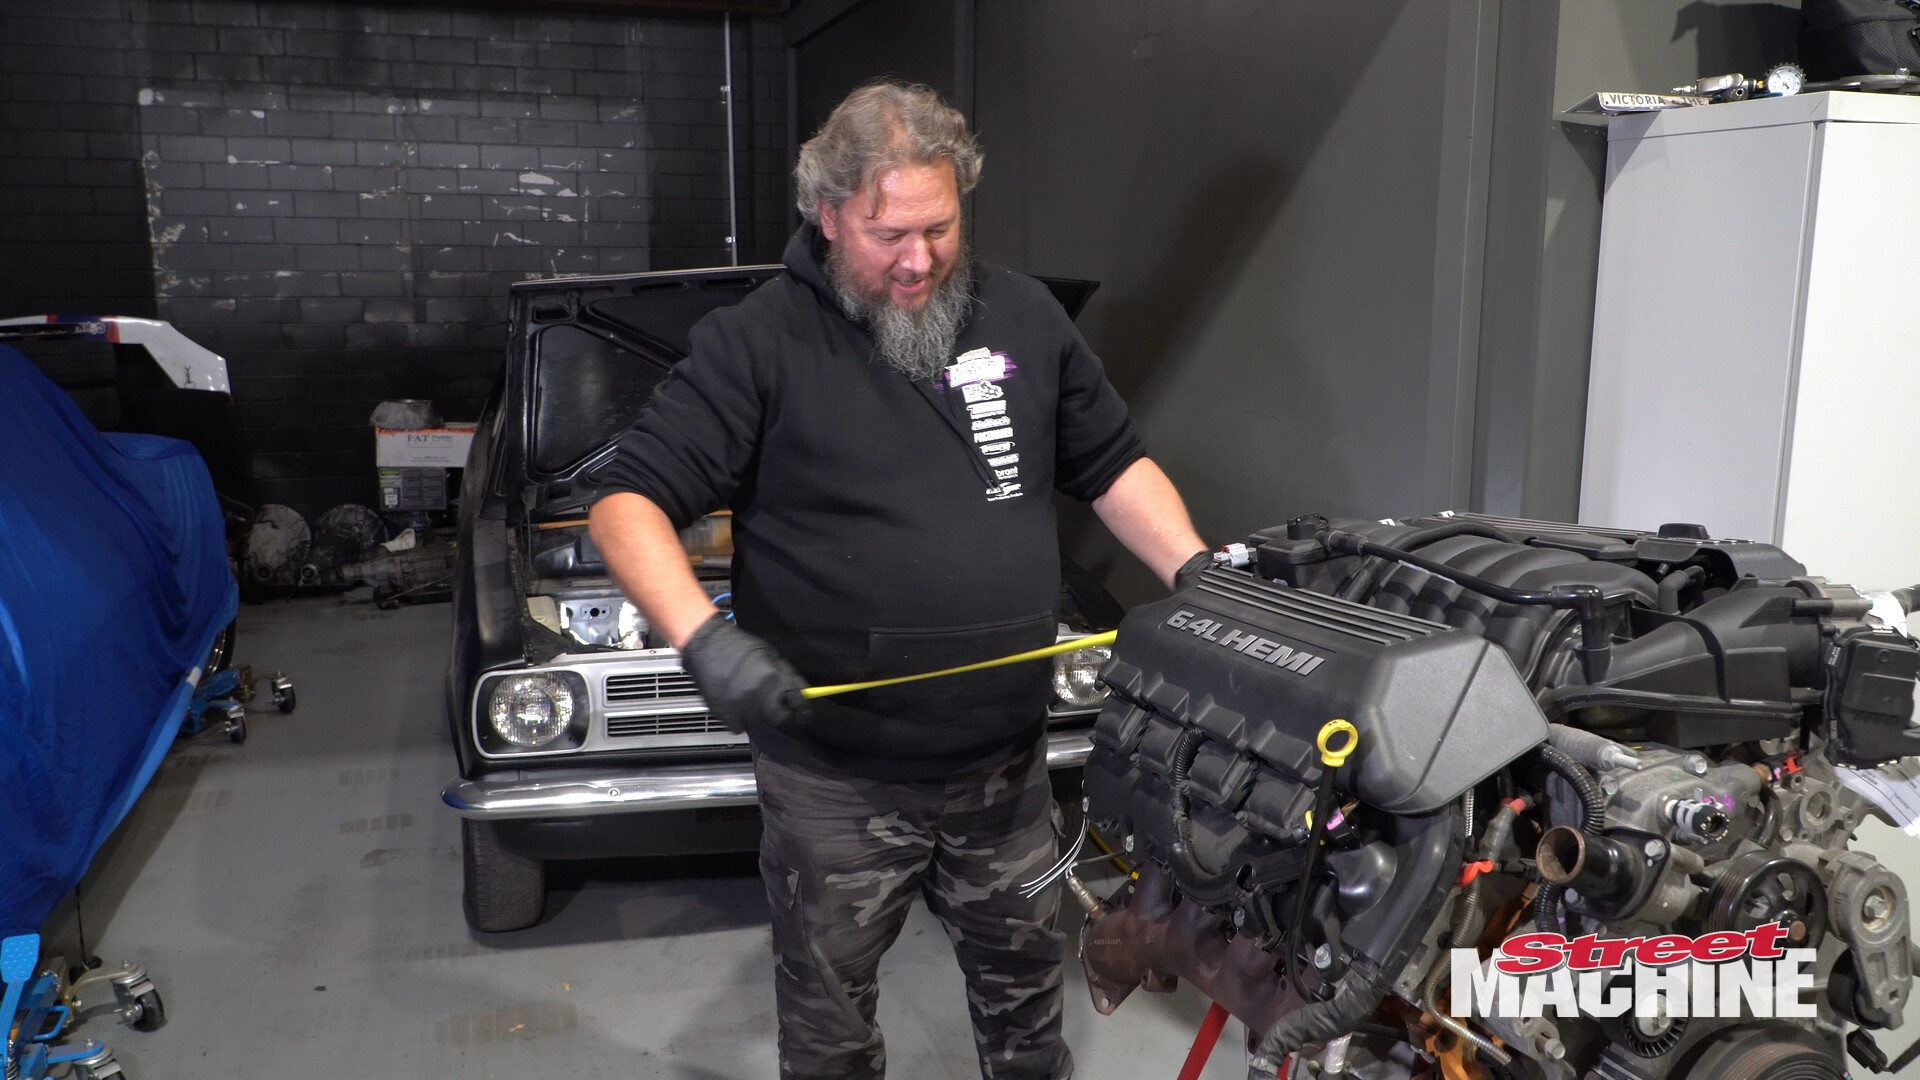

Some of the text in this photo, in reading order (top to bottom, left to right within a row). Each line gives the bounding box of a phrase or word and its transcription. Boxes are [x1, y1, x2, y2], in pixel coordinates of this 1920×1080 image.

[1609, 94, 1667, 105] VICTORIA
[1166, 610, 1326, 677] 6.4L HEMI
